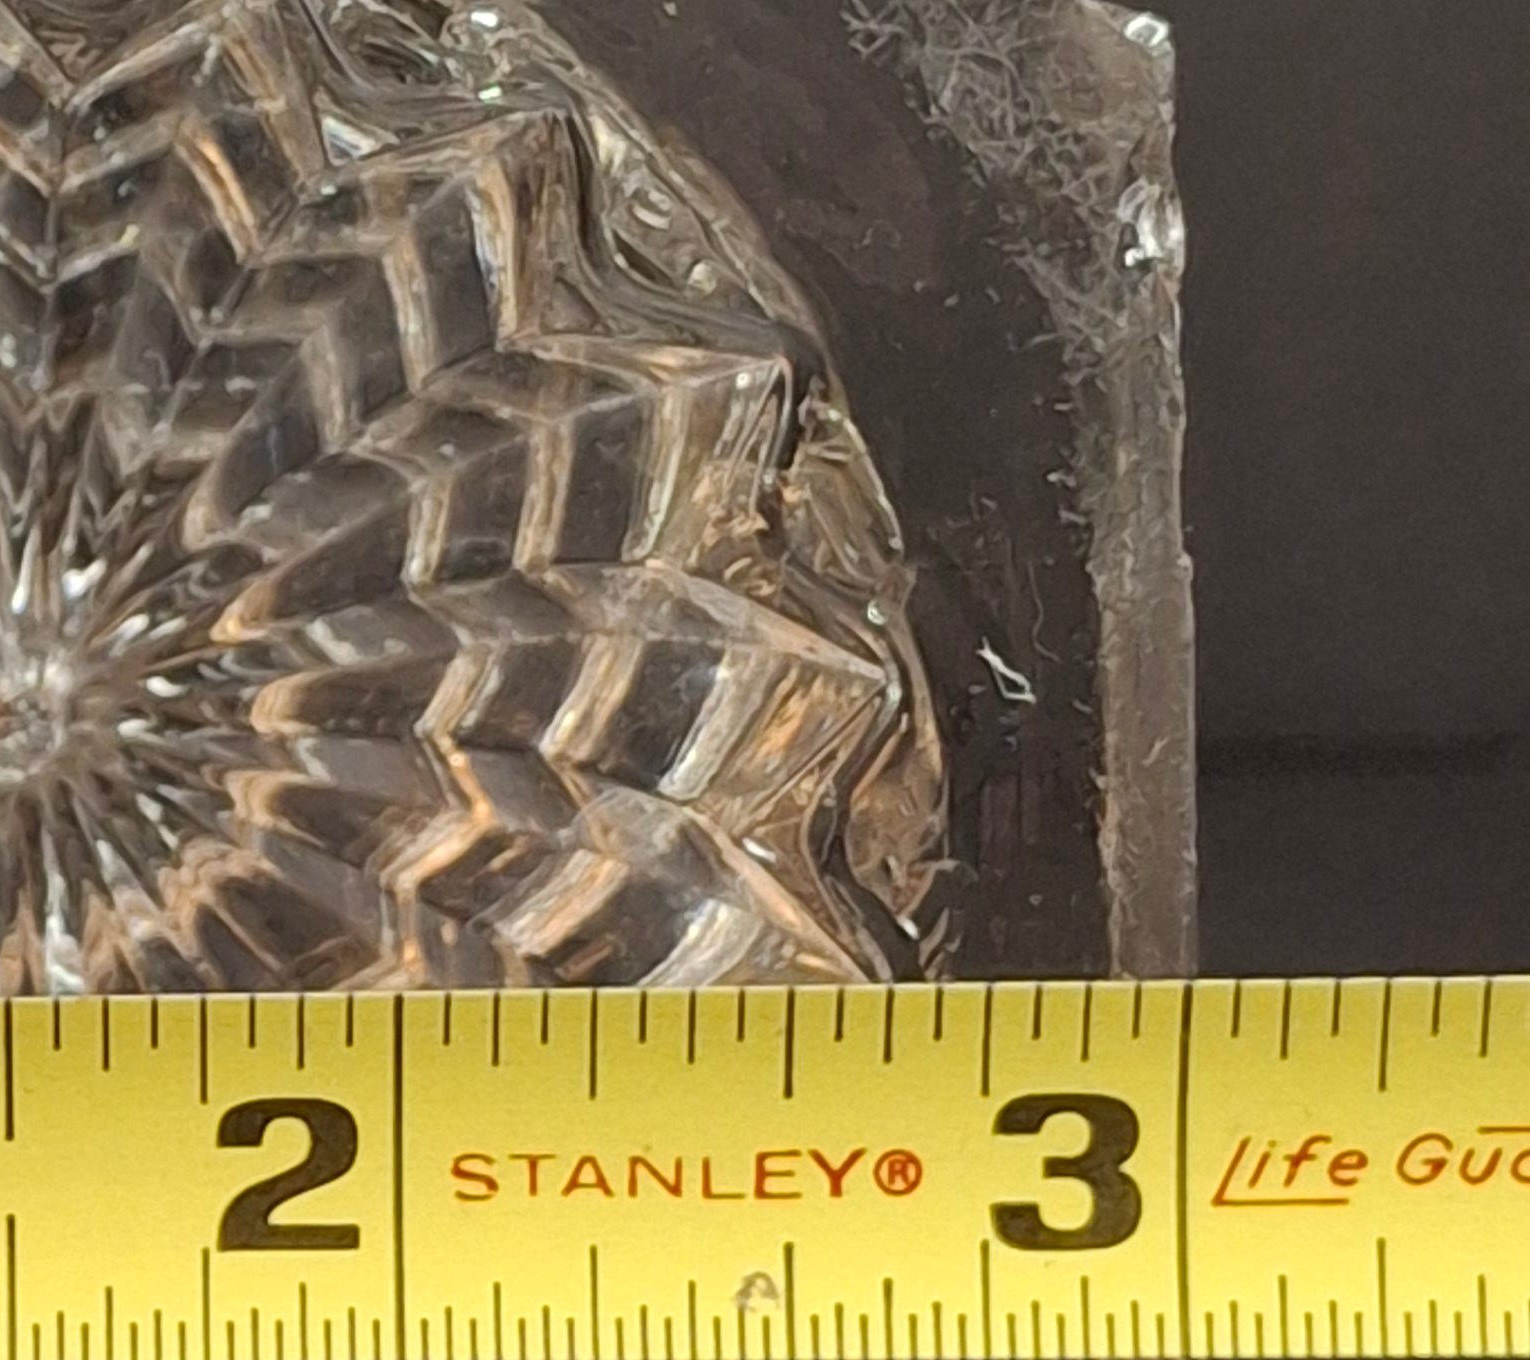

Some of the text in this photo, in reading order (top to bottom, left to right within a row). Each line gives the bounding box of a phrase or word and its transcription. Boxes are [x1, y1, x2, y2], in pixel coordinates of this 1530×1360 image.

[215, 1097, 361, 1252] 2
[989, 1092, 1143, 1251] 3
[1211, 1134, 1370, 1207] Life
